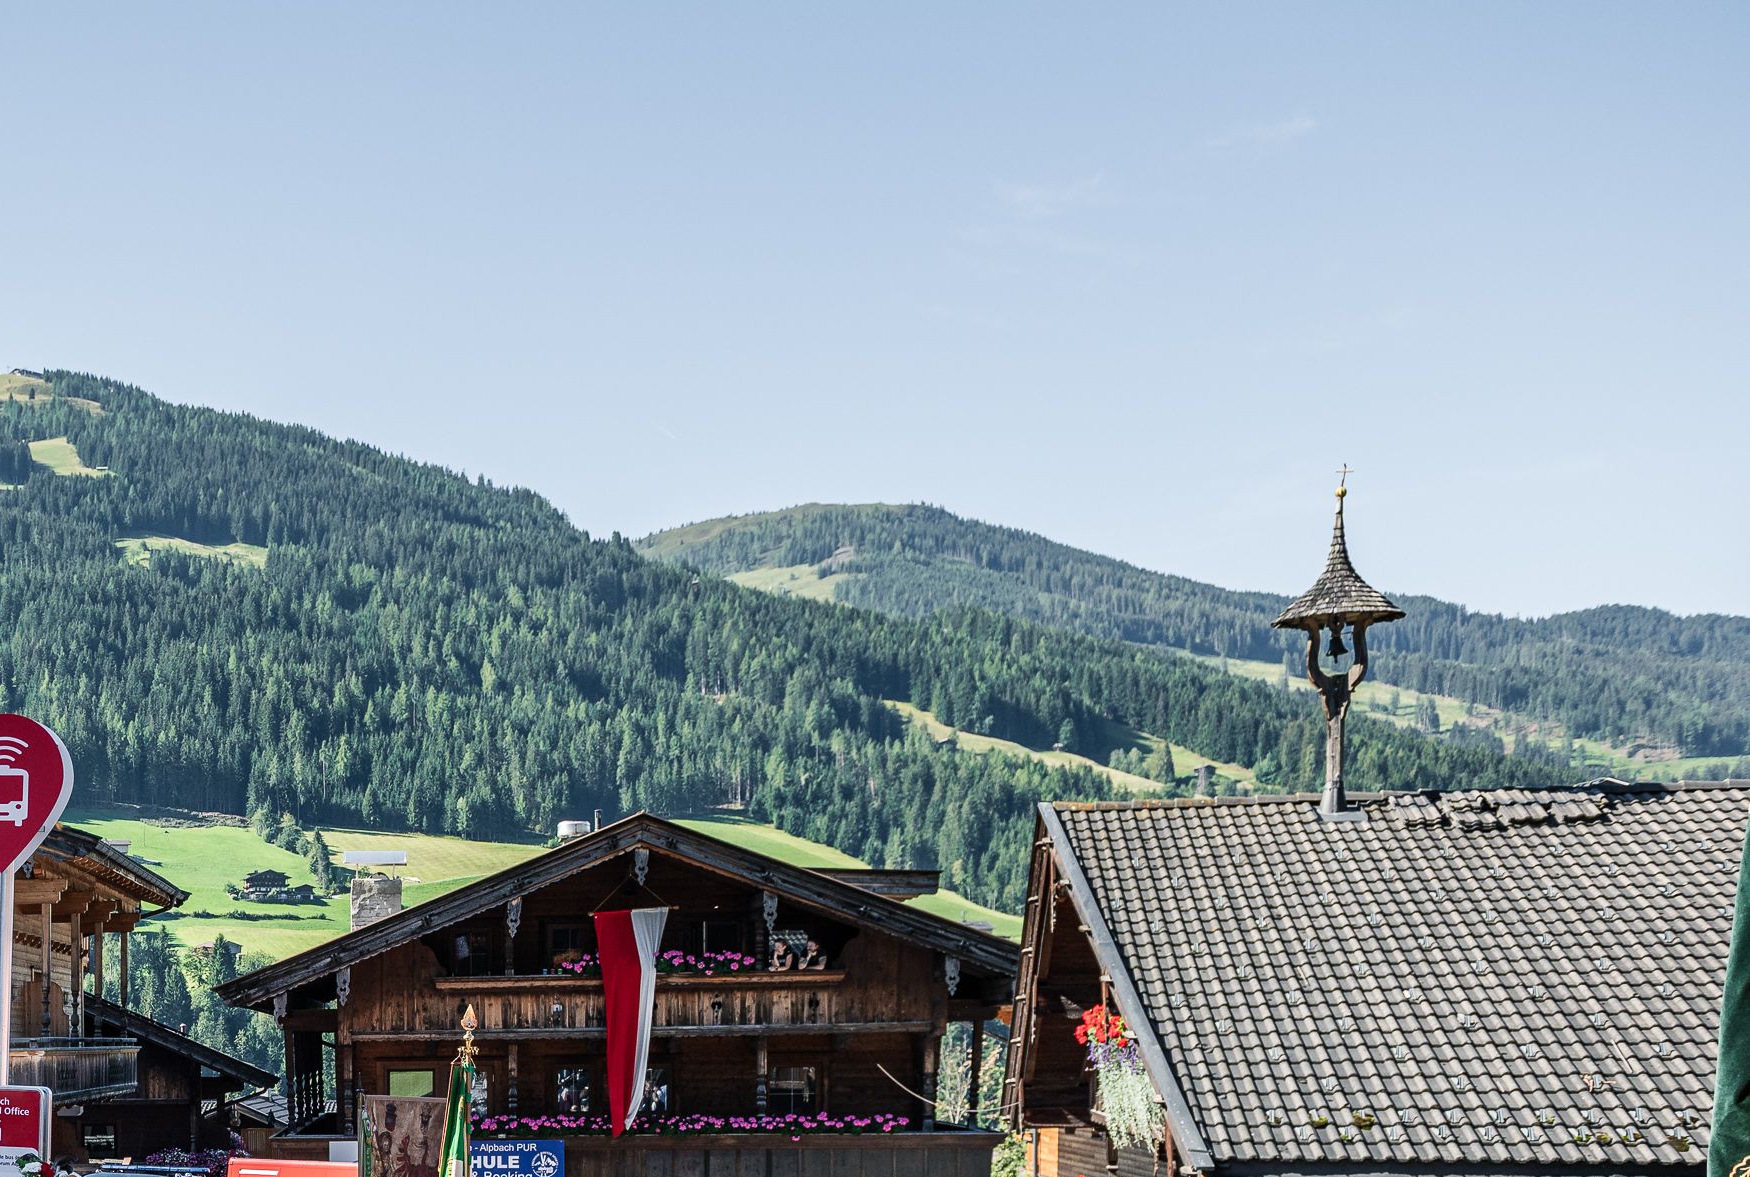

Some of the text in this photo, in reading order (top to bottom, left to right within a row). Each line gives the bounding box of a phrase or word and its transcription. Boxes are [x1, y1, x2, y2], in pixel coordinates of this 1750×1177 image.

[4, 1107, 30, 1116] Office
[479, 1143, 515, 1153] Alpbach
[516, 1143, 537, 1152] PUR
